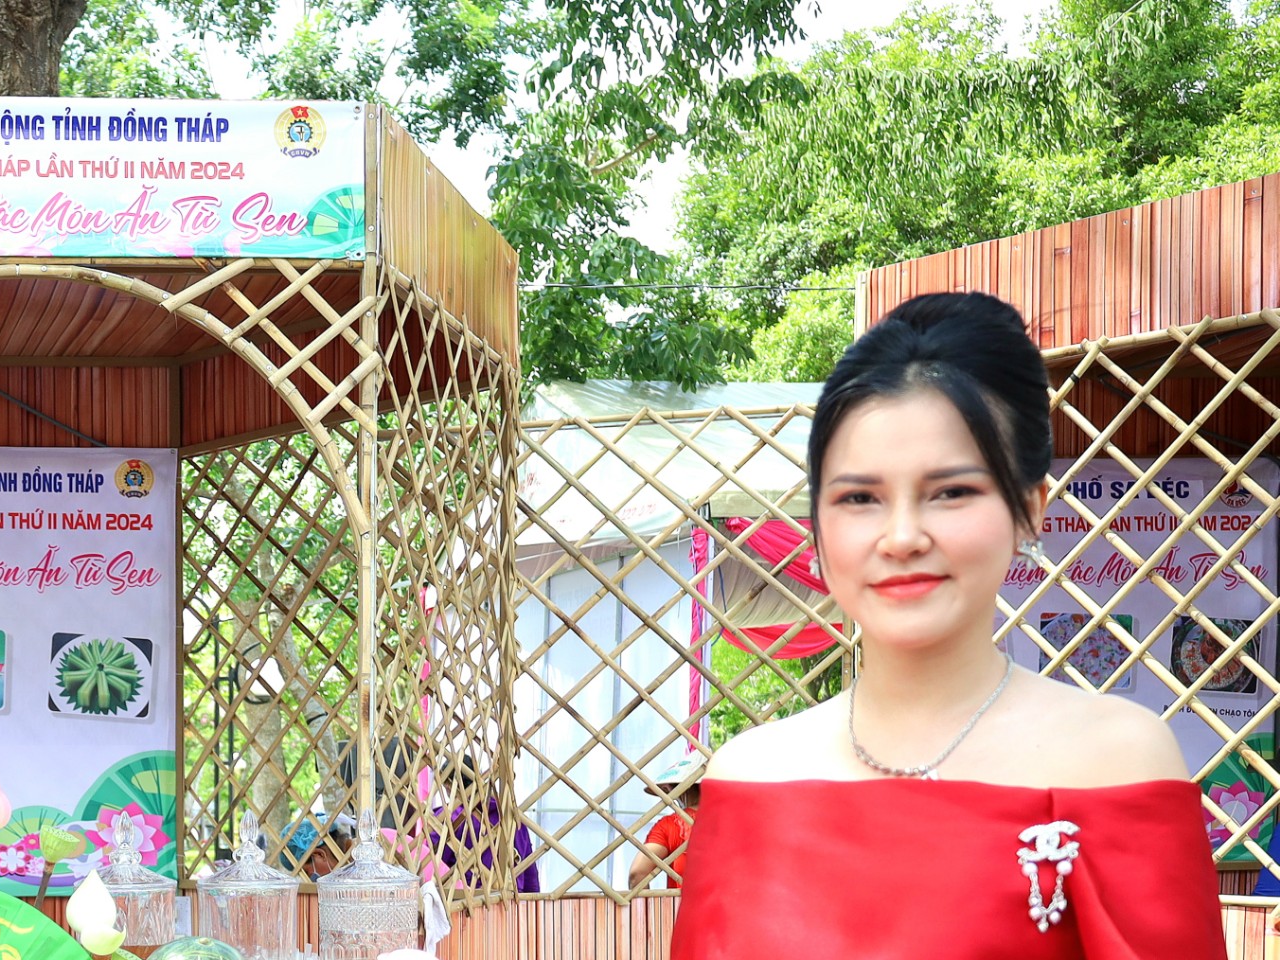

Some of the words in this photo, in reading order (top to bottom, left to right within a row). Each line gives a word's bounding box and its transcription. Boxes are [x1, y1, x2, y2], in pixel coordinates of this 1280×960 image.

[52, 107, 101, 141] TỈNH
[108, 108, 167, 142] ĐỒNG
[174, 112, 230, 143] THÁP
[36, 152, 74, 179] LẦN
[79, 156, 120, 179] THỨ
[124, 160, 135, 180] II
[141, 156, 186, 180] NĂM
[190, 161, 245, 180] 2024
[30, 191, 113, 237] Món
[115, 184, 172, 242] Ăn
[172, 194, 222, 234] Từ
[232, 192, 308, 243] Sen
[22, 466, 63, 493] ĐỒNG
[67, 469, 104, 494] THÁP
[8, 508, 44, 530] THỨ
[47, 512, 57, 530] II
[62, 509, 101, 530] NĂM
[105, 513, 154, 531] 2024
[1134, 511, 1166, 532] THỨ
[1220, 515, 1261, 531] 202
[28, 544, 69, 593] Ăn
[70, 553, 106, 589] Từ
[106, 551, 161, 595] Sen
